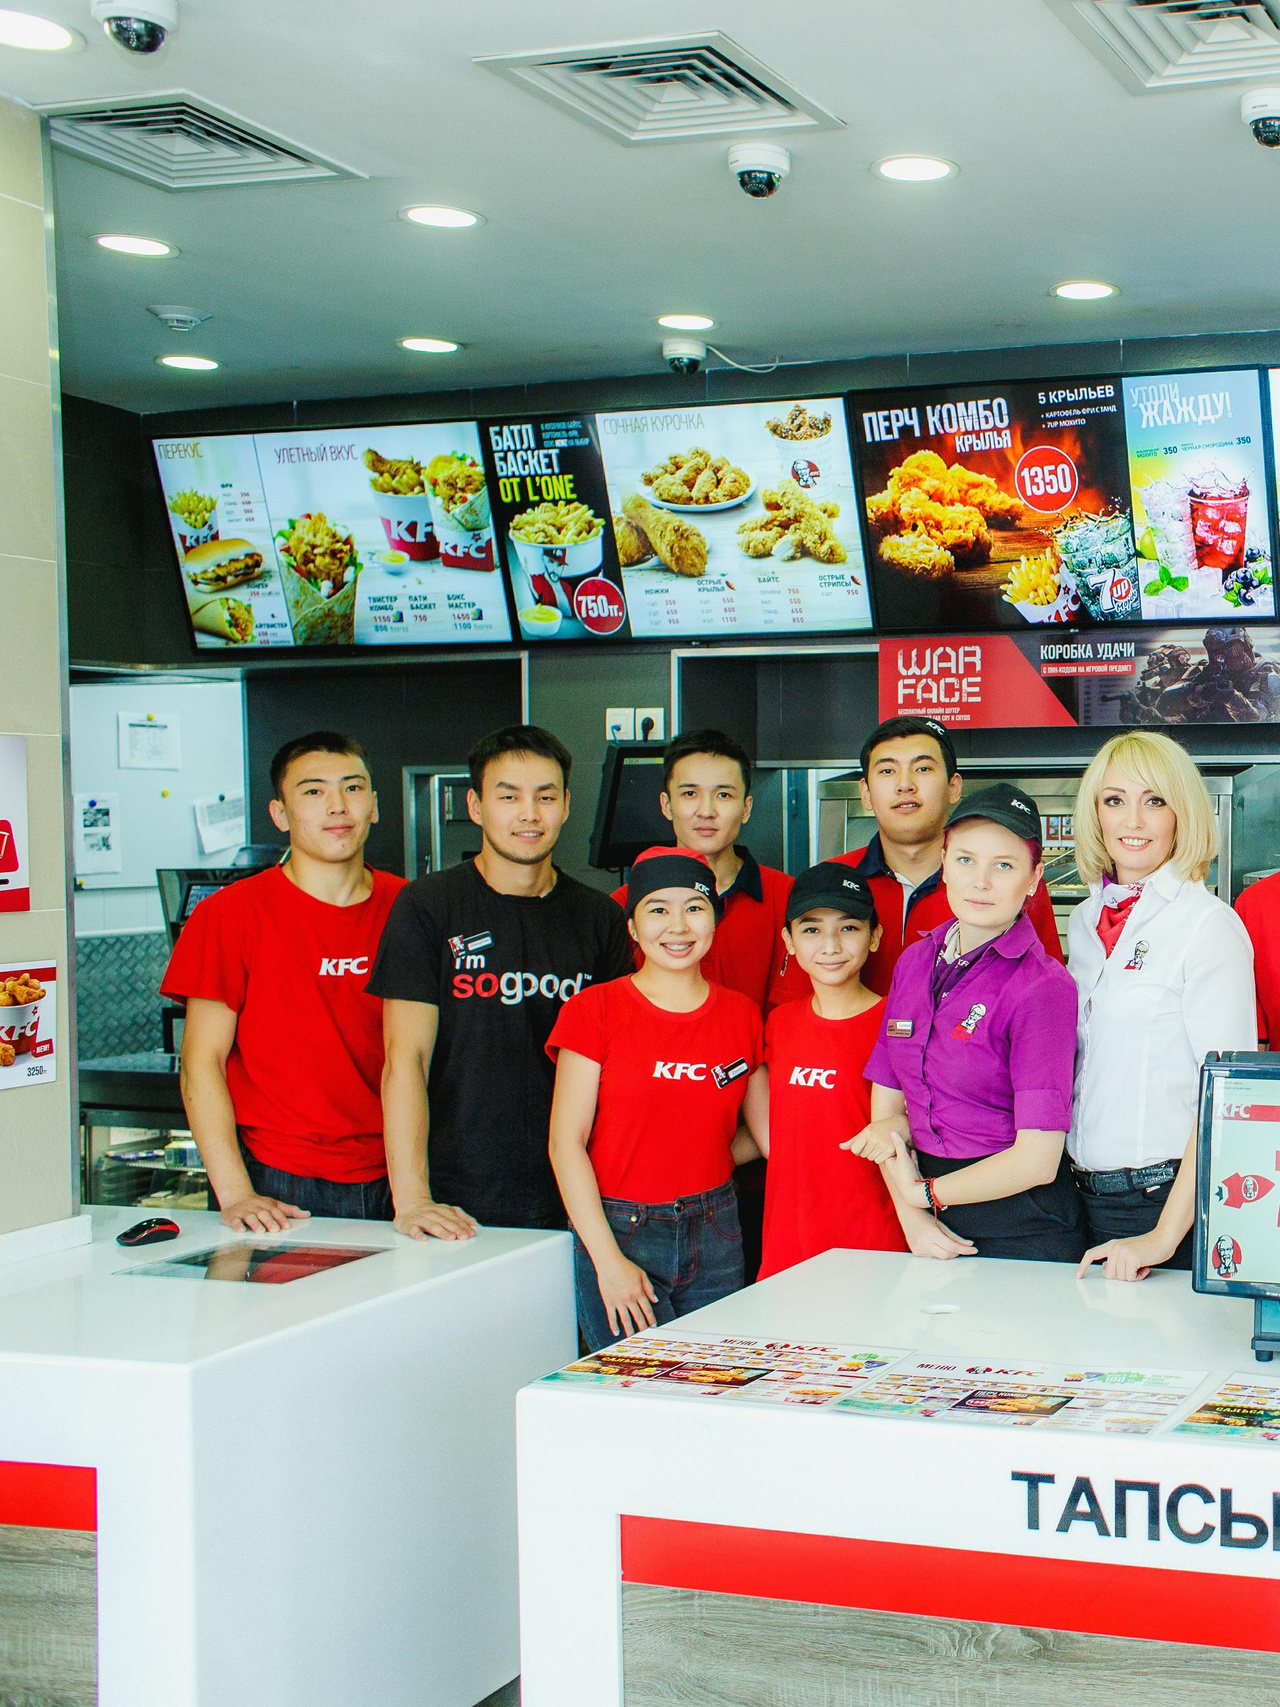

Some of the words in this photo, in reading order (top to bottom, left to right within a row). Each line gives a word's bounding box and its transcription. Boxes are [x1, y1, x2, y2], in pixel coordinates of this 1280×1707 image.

[1038, 392, 1046, 405] 5
[1049, 385, 1115, 403] КРЫЛЬЕВ
[1129, 382, 1180, 407] УТОЛИ
[1139, 392, 1233, 428] ЖАЖДУ!
[603, 418, 649, 435] СОЧНАЯ
[651, 414, 705, 432] КУРОЧКА
[862, 411, 921, 443] ПЕРЧ
[928, 398, 1009, 436] КОМБО
[489, 424, 536, 451] БАТЛ
[956, 431, 1011, 454] КРЫЛЬЯ
[1236, 436, 1251, 445] 350
[158, 441, 204, 460] ПЕРЕКУС
[274, 445, 328, 464] УЛЕТНЫЙ
[329, 444, 359, 461] ВКУС
[1163, 446, 1178, 454] 350
[494, 449, 560, 477] БАСКЕТ
[499, 477, 521, 503] ОТ
[1020, 463, 1072, 497] 1350
[440, 541, 488, 559] KFC
[897, 645, 982, 676] WAR
[1040, 644, 1093, 660] КОРОБКА
[1097, 642, 1135, 660] УДАЧИ
[897, 677, 982, 705] FACE
[926, 721, 945, 735] KFC
[1011, 798, 1031, 815] KFC
[694, 882, 711, 897] KFC
[842, 879, 860, 893] KFC
[319, 956, 369, 976] KFC
[36, 1043, 50, 1053] NEW!
[652, 1061, 707, 1081] KFC
[789, 1066, 836, 1089] KFC
[1216, 1103, 1251, 1118] KFC
[917, 1363, 957, 1372] МЕНЮ
[994, 1368, 1044, 1378] KFC
